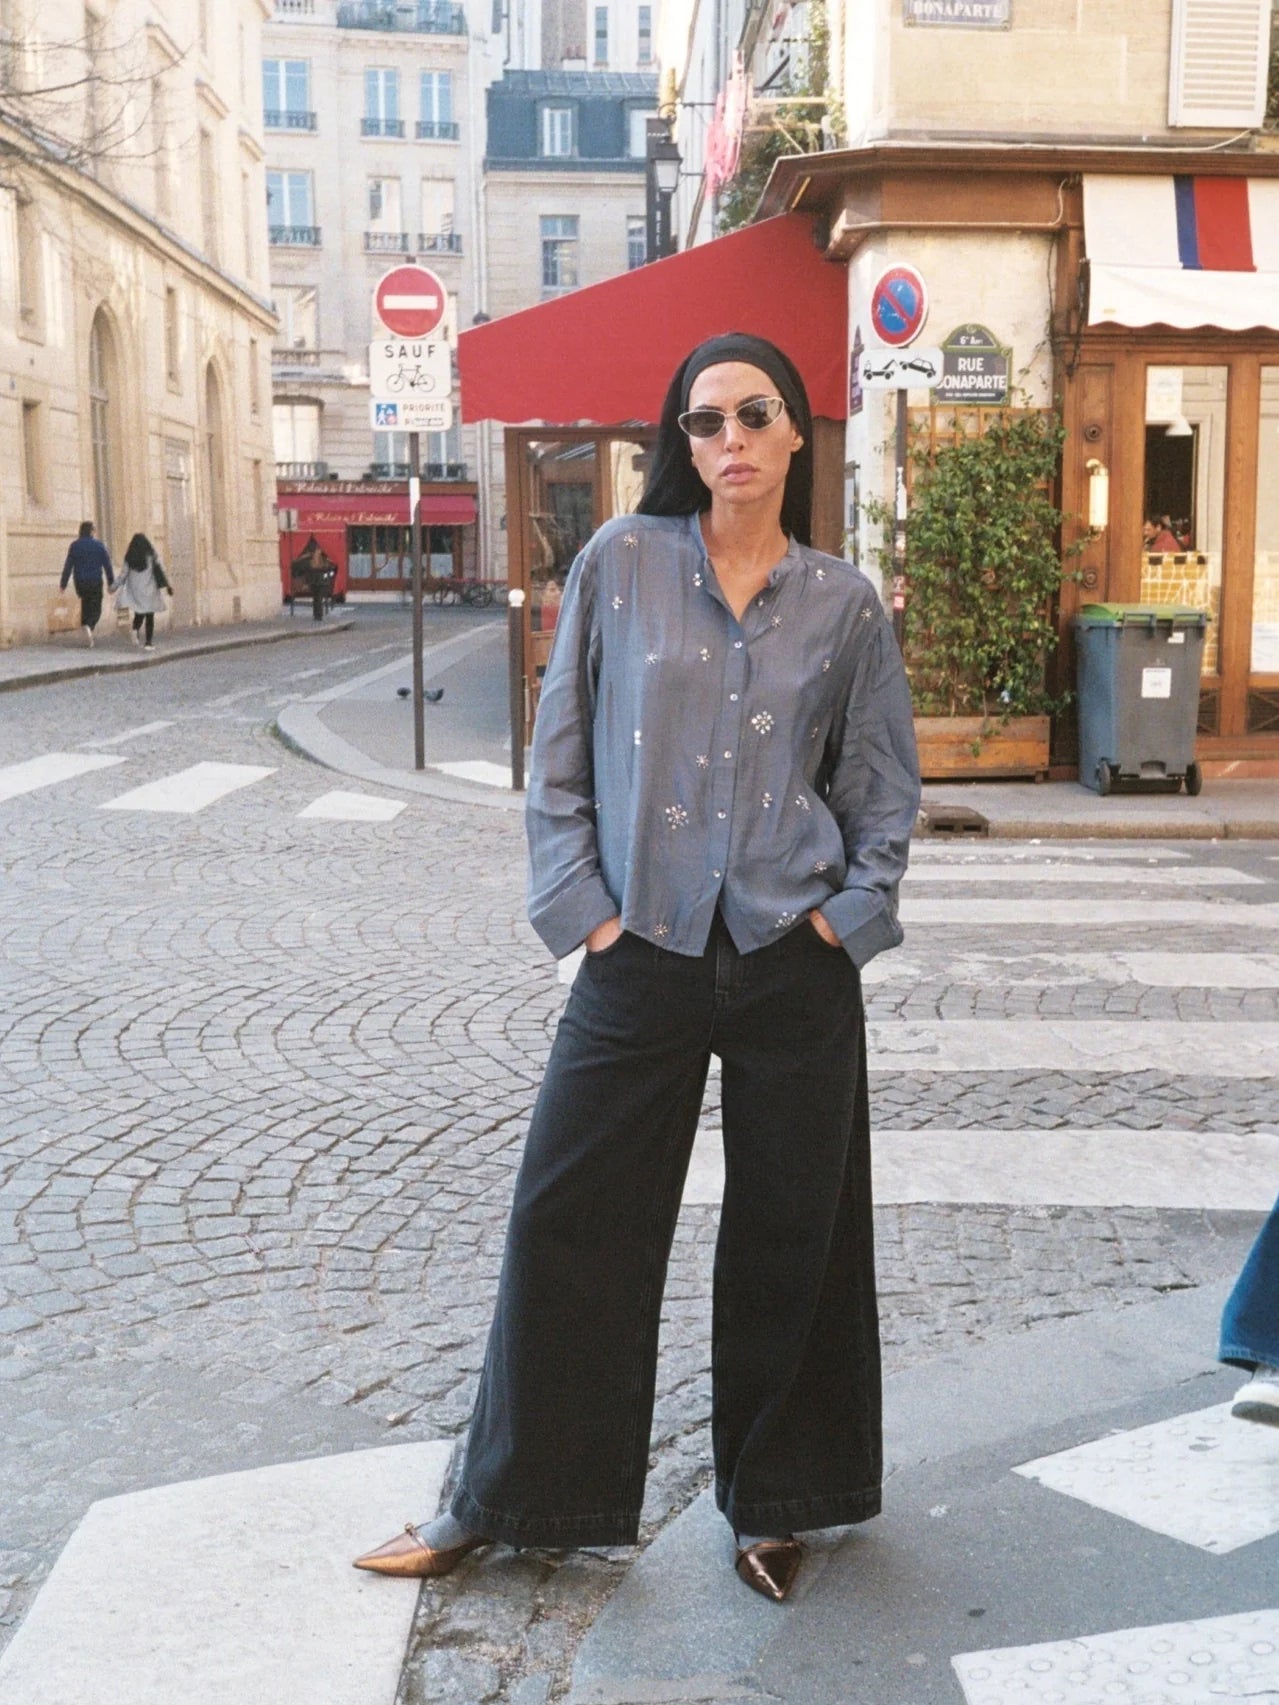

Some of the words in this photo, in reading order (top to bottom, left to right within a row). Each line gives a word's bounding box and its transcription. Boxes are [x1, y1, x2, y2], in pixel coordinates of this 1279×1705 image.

[384, 344, 436, 359] SAUF
[958, 357, 985, 372] RUE
[937, 374, 1007, 390] ONAPARTE
